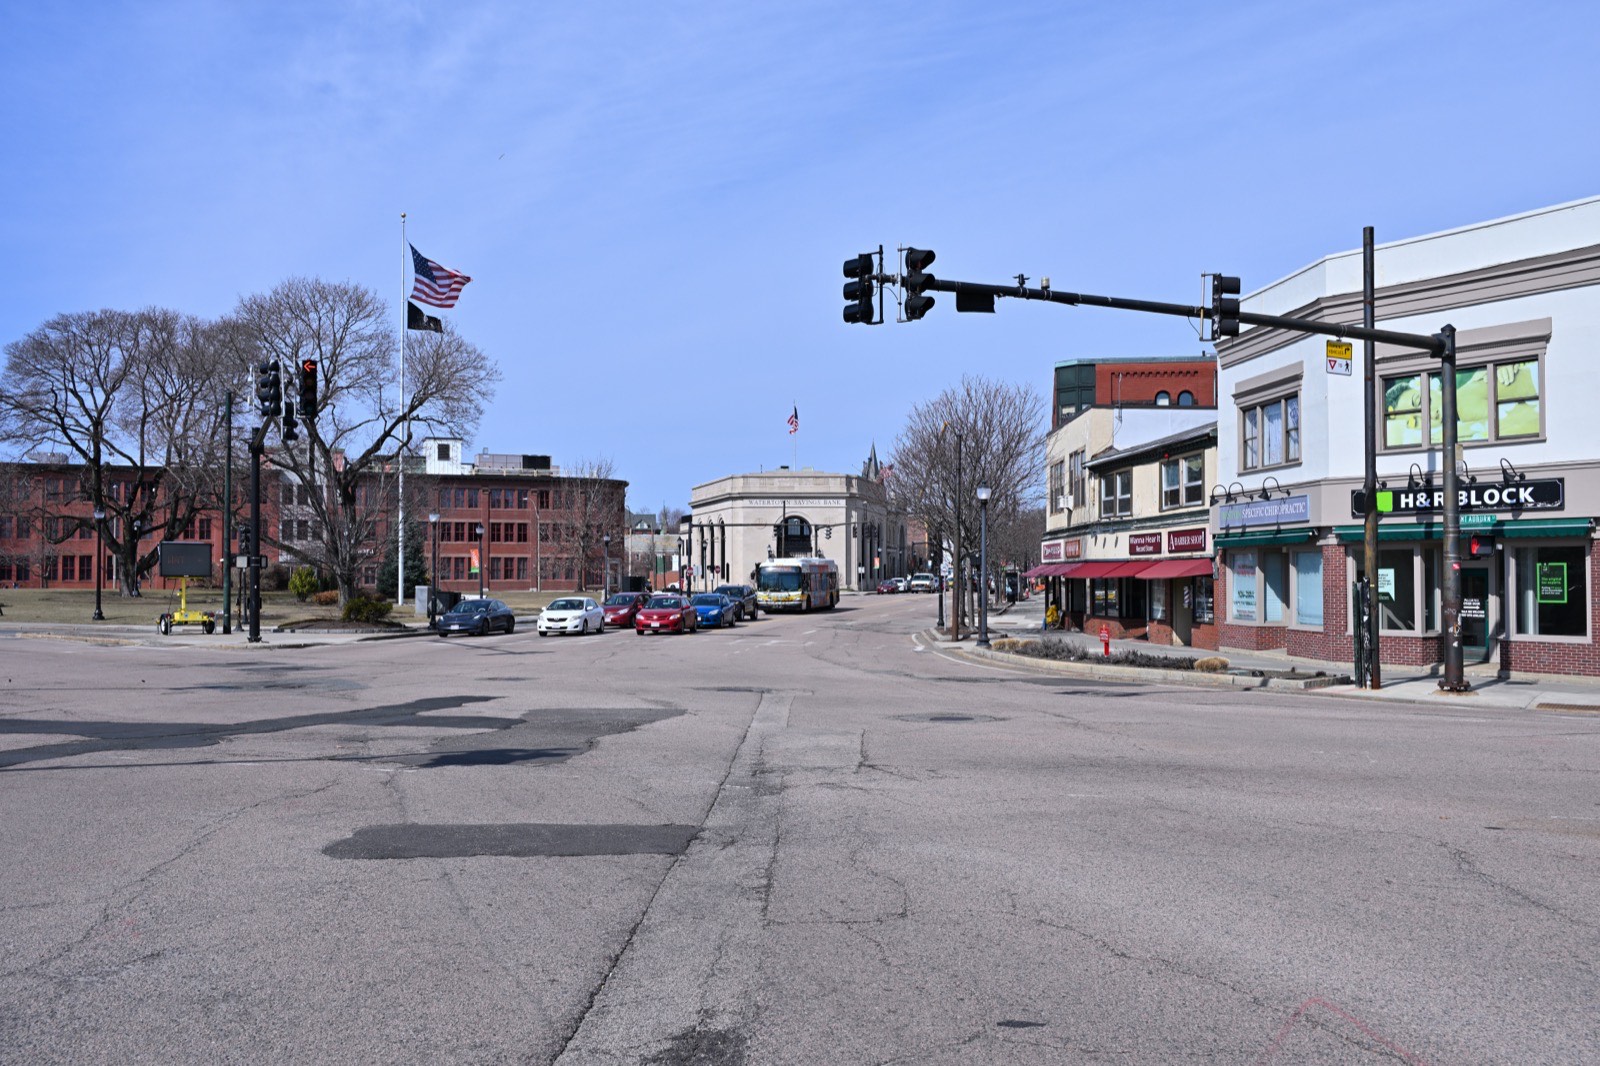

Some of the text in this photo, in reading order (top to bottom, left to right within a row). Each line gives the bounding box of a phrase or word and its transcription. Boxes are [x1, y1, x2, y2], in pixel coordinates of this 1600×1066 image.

[1400, 486, 1535, 508] H&R BLOCK
[1241, 507, 1264, 519] SPECIFIC
[1264, 502, 1306, 517] CHIROPRACTIC
[1129, 536, 1145, 544] Wanna
[1174, 536, 1190, 546] BARBER
